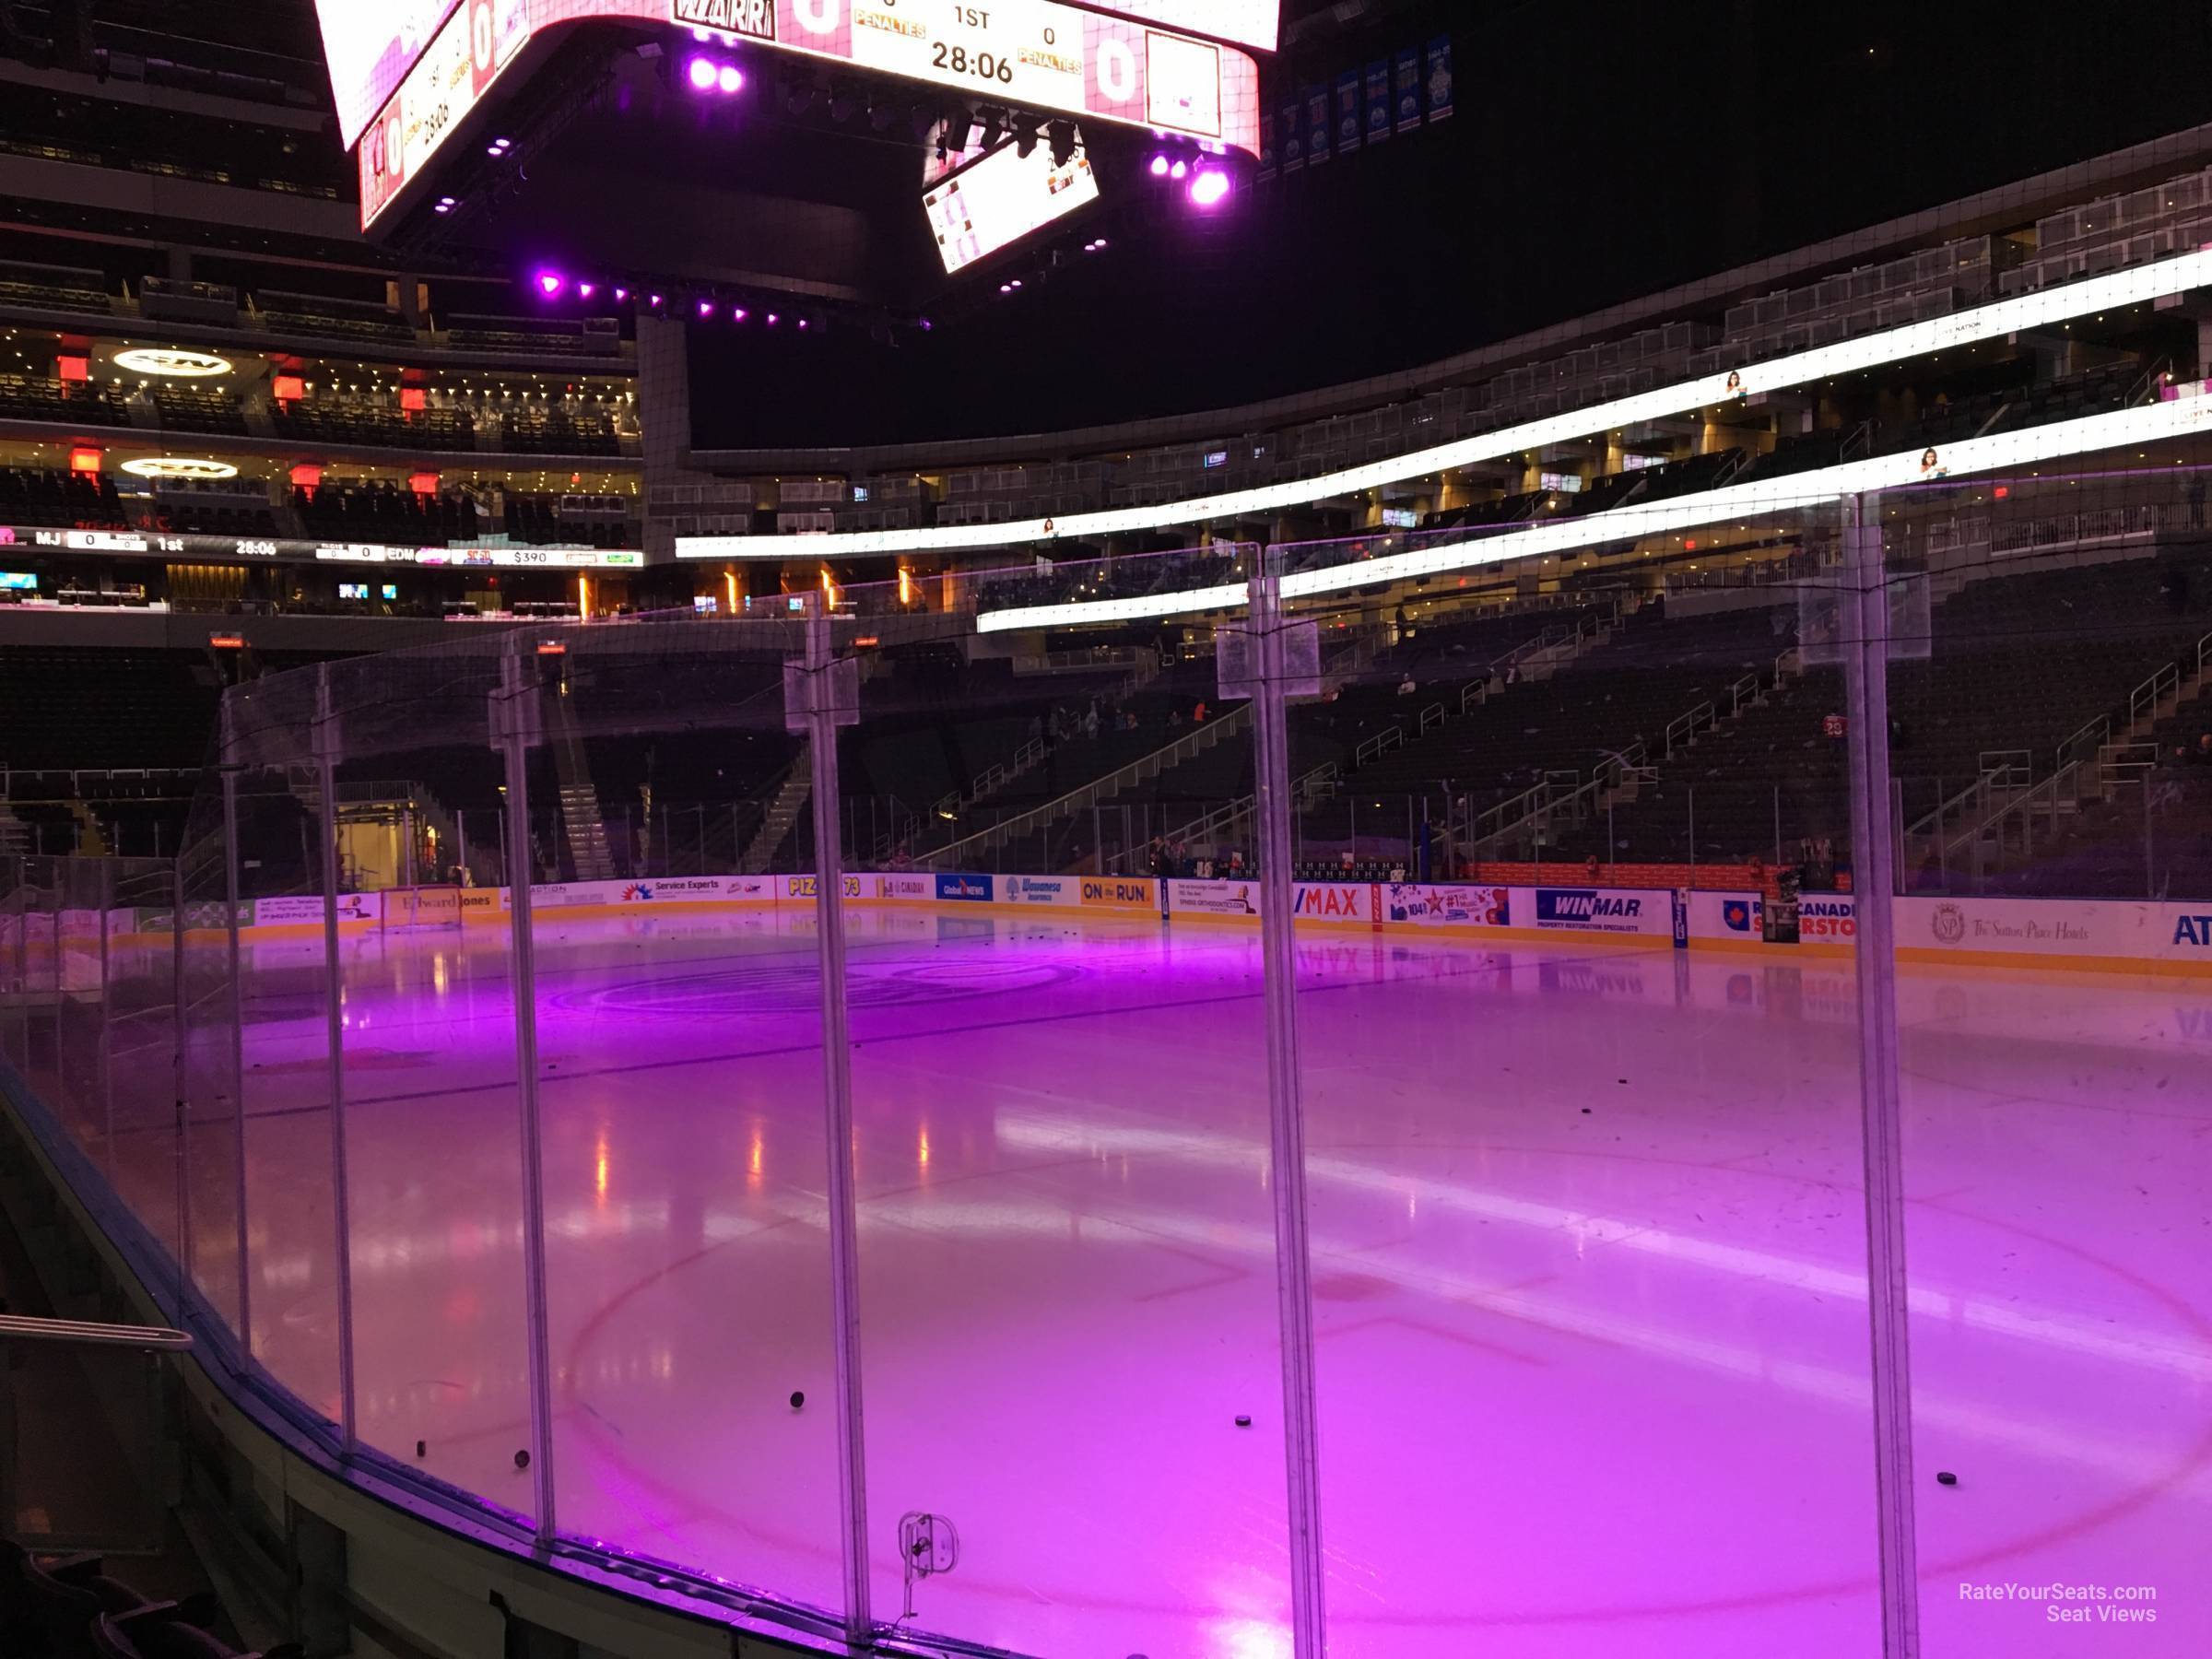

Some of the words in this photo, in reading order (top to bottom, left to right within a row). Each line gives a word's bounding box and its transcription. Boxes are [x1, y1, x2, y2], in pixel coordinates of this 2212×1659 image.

[854, 9, 925, 39] PENALTIES
[955, 6, 990, 29] 1ST
[1043, 28, 1055, 45] 0
[932, 41, 1013, 84] 28:06
[1018, 48, 1082, 76] PENALTIES
[1097, 39, 1135, 101] 0
[36, 531, 61, 546] MJ
[86, 535, 95, 545] 0
[158, 537, 183, 551] 1st
[237, 540, 276, 556] 28:06
[362, 547, 371, 558] 0
[387, 547, 414, 561] EDM
[514, 552, 547, 563] $390
[655, 881, 686, 890] Service
[688, 879, 719, 891] Experts
[789, 878, 818, 896] PIZ
[844, 877, 860, 896] 73
[944, 885, 961, 895] Global
[968, 886, 984, 896] NEWS
[1022, 878, 1061, 892] Wawanesa
[1083, 883, 1103, 900] ON
[1116, 884, 1145, 901] RUN
[1294, 887, 1358, 916] /MAX
[1555, 896, 1641, 917] WINMAR
[1604, 924, 1639, 933] SPECIALISTS
[1972, 919, 1988, 936] The
[1993, 922, 2023, 937] Sutton
[2027, 920, 2051, 938] Place
[2055, 922, 2089, 940] Hotels
